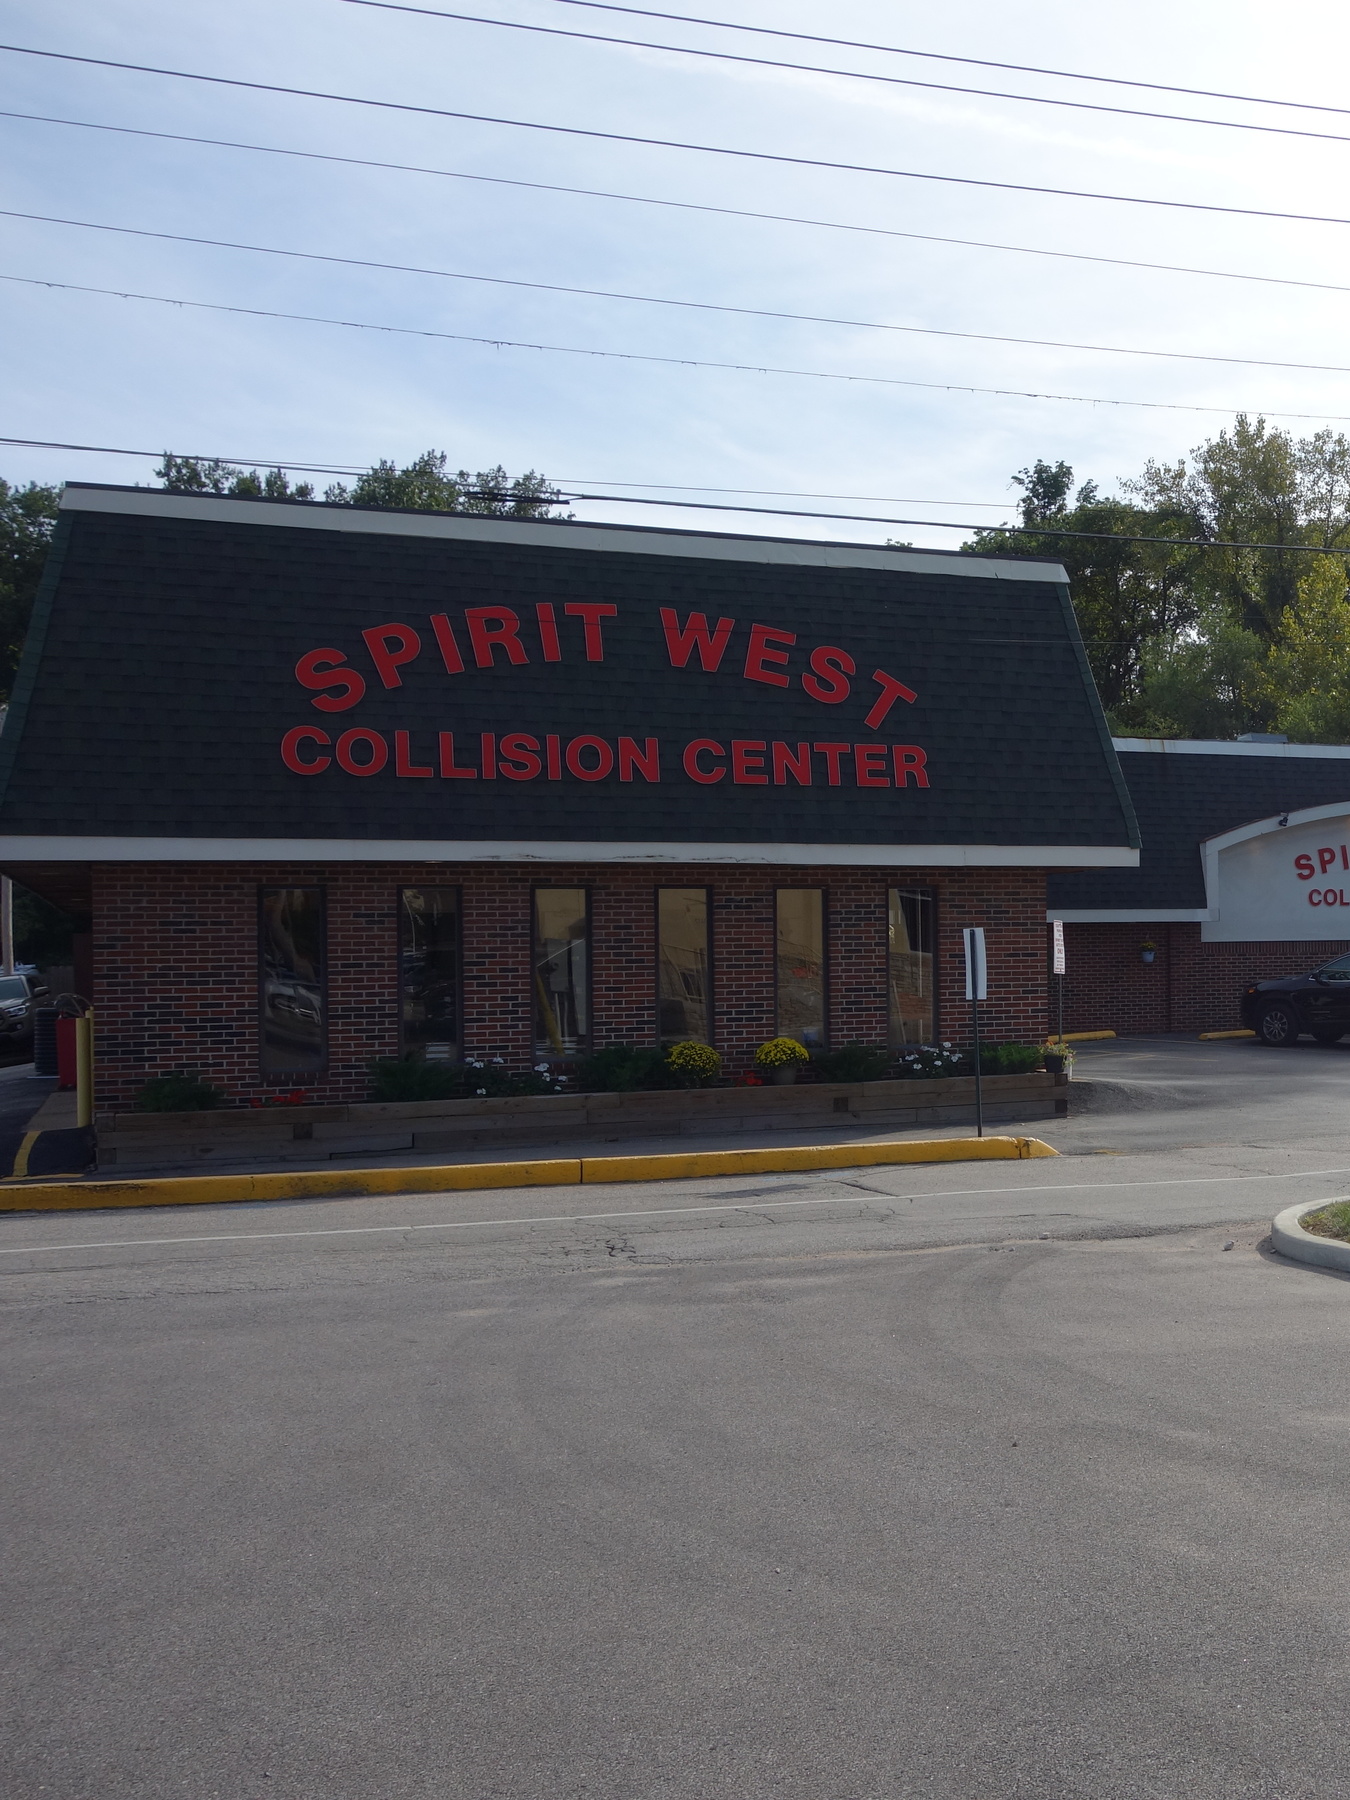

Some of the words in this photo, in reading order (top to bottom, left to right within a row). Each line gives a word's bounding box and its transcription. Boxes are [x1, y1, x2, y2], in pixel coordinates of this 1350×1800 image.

[294, 602, 618, 713] SPIRIT
[659, 606, 918, 730] WEST
[280, 725, 661, 783] COLLISION
[682, 738, 931, 788] CENTER
